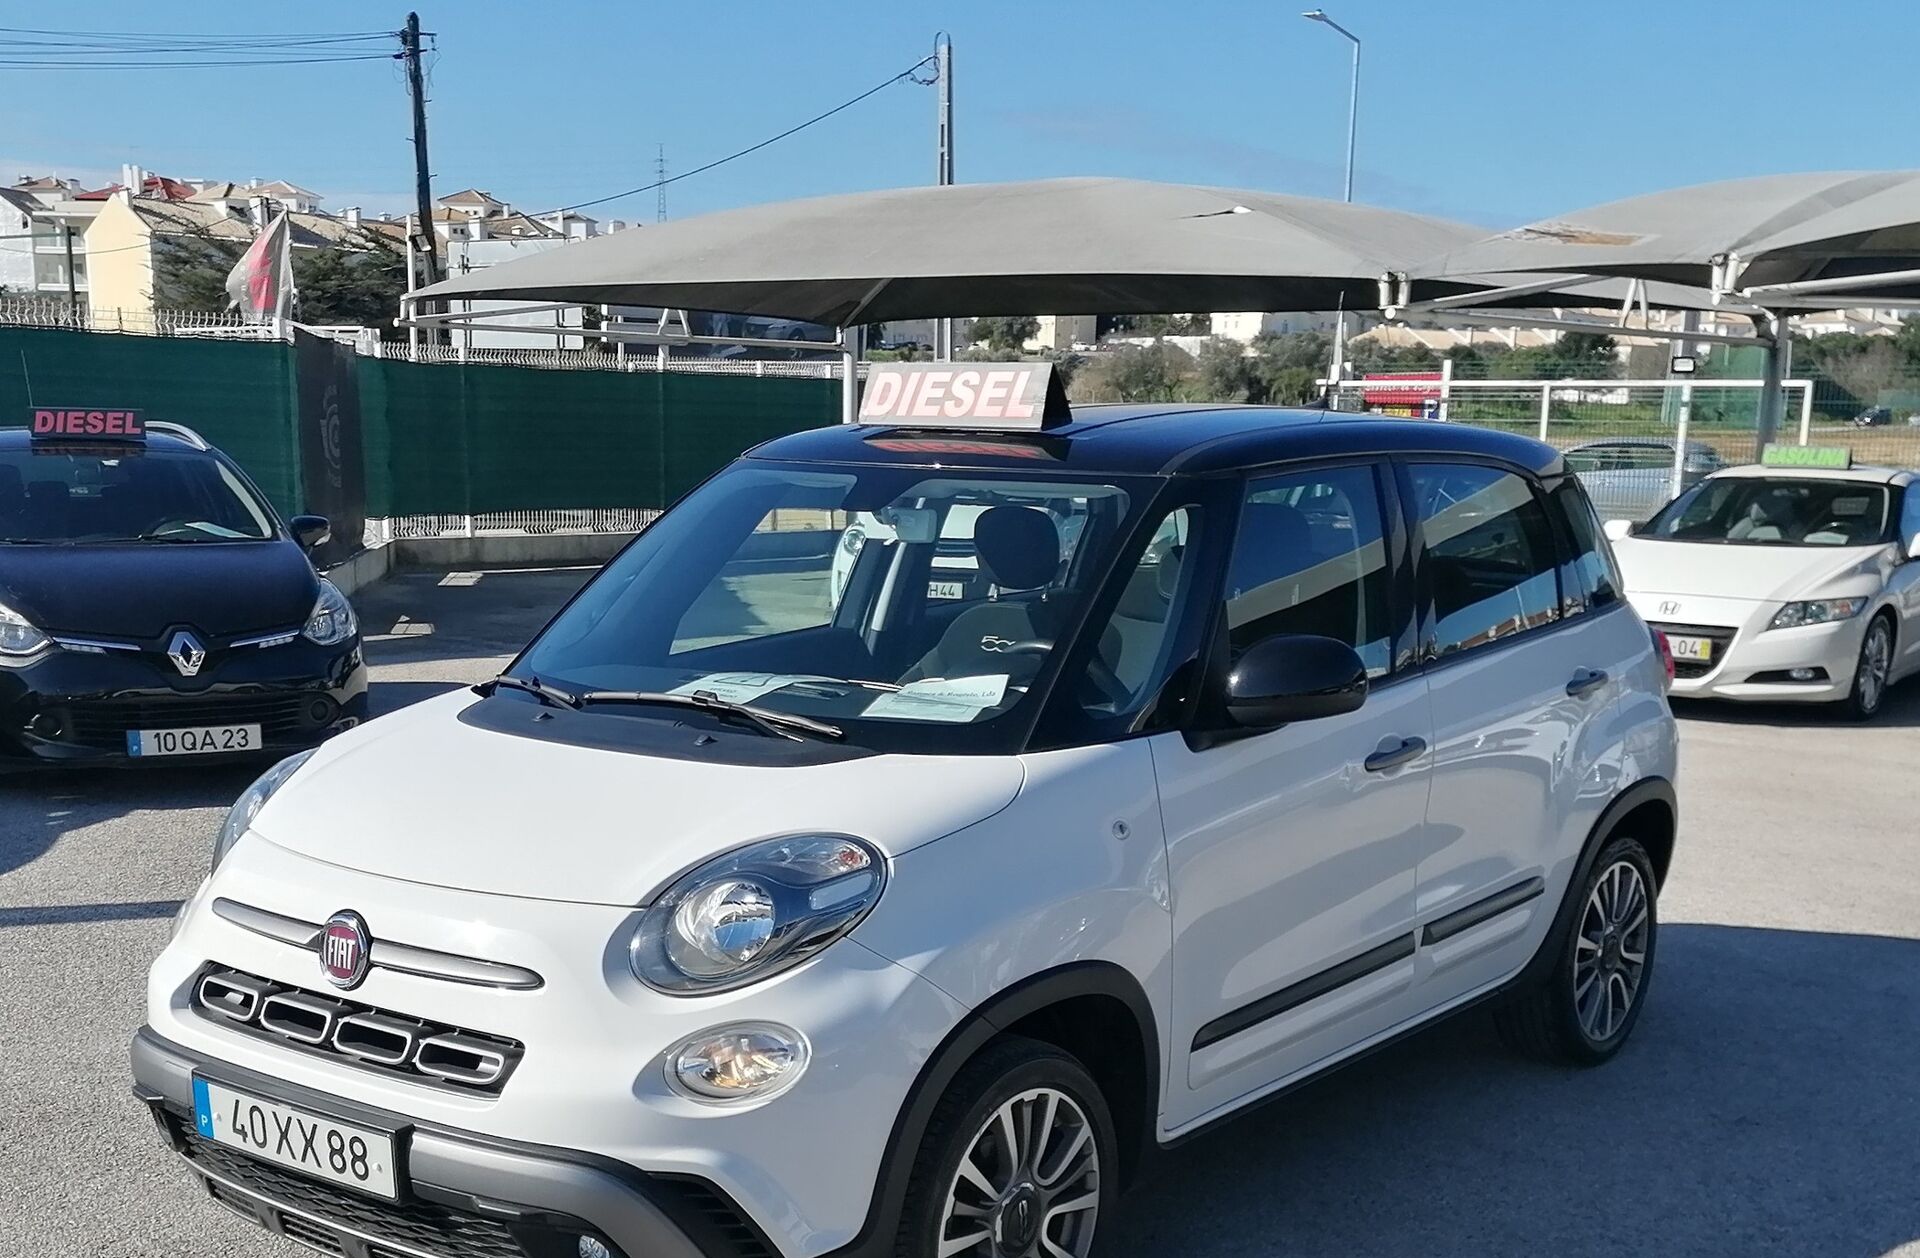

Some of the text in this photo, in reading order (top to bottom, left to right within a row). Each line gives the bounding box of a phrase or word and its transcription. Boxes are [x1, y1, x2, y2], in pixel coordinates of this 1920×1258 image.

[863, 371, 1034, 418] DIESEL
[34, 411, 141, 434] DIESEL
[1763, 446, 1846, 466] GASOLINA
[328, 935, 356, 970] FIAT
